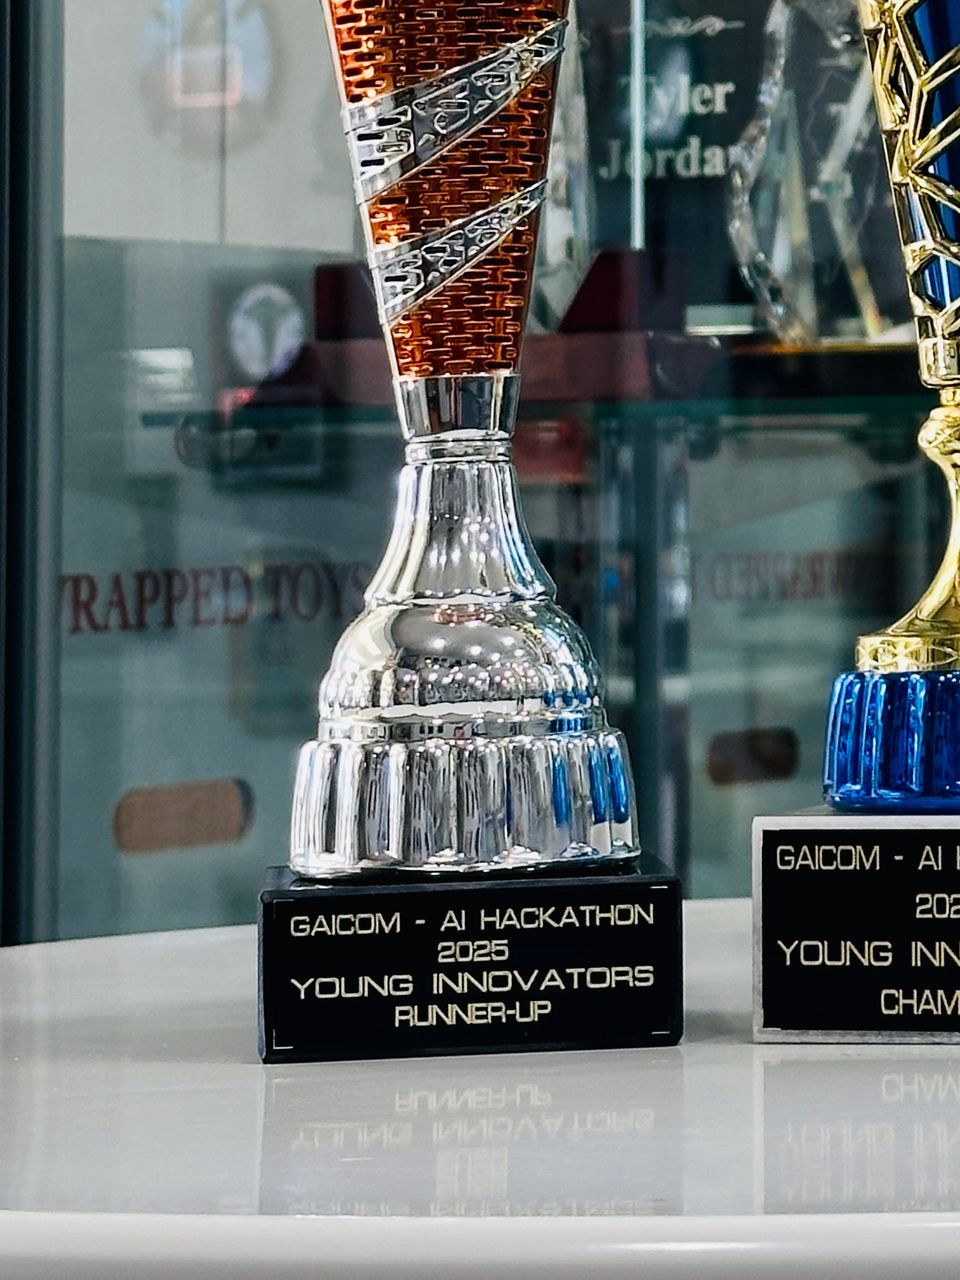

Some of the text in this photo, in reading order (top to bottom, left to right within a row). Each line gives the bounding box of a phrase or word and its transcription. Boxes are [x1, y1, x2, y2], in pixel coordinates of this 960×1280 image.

[617, 72, 737, 126] yler
[598, 134, 736, 180] Jrda
[58, 565, 252, 635] RAPPED
[776, 845, 880, 871] GAICOM
[918, 845, 942, 871] AI
[290, 912, 401, 937] GAICOM
[440, 909, 466, 931] AI
[480, 904, 654, 931] HACKATHON
[437, 940, 509, 963] 2025
[777, 940, 893, 967] YOUNG
[290, 965, 654, 1000] YOUNG INNOVATORS
[394, 1000, 552, 1028] RUNNER-UP
